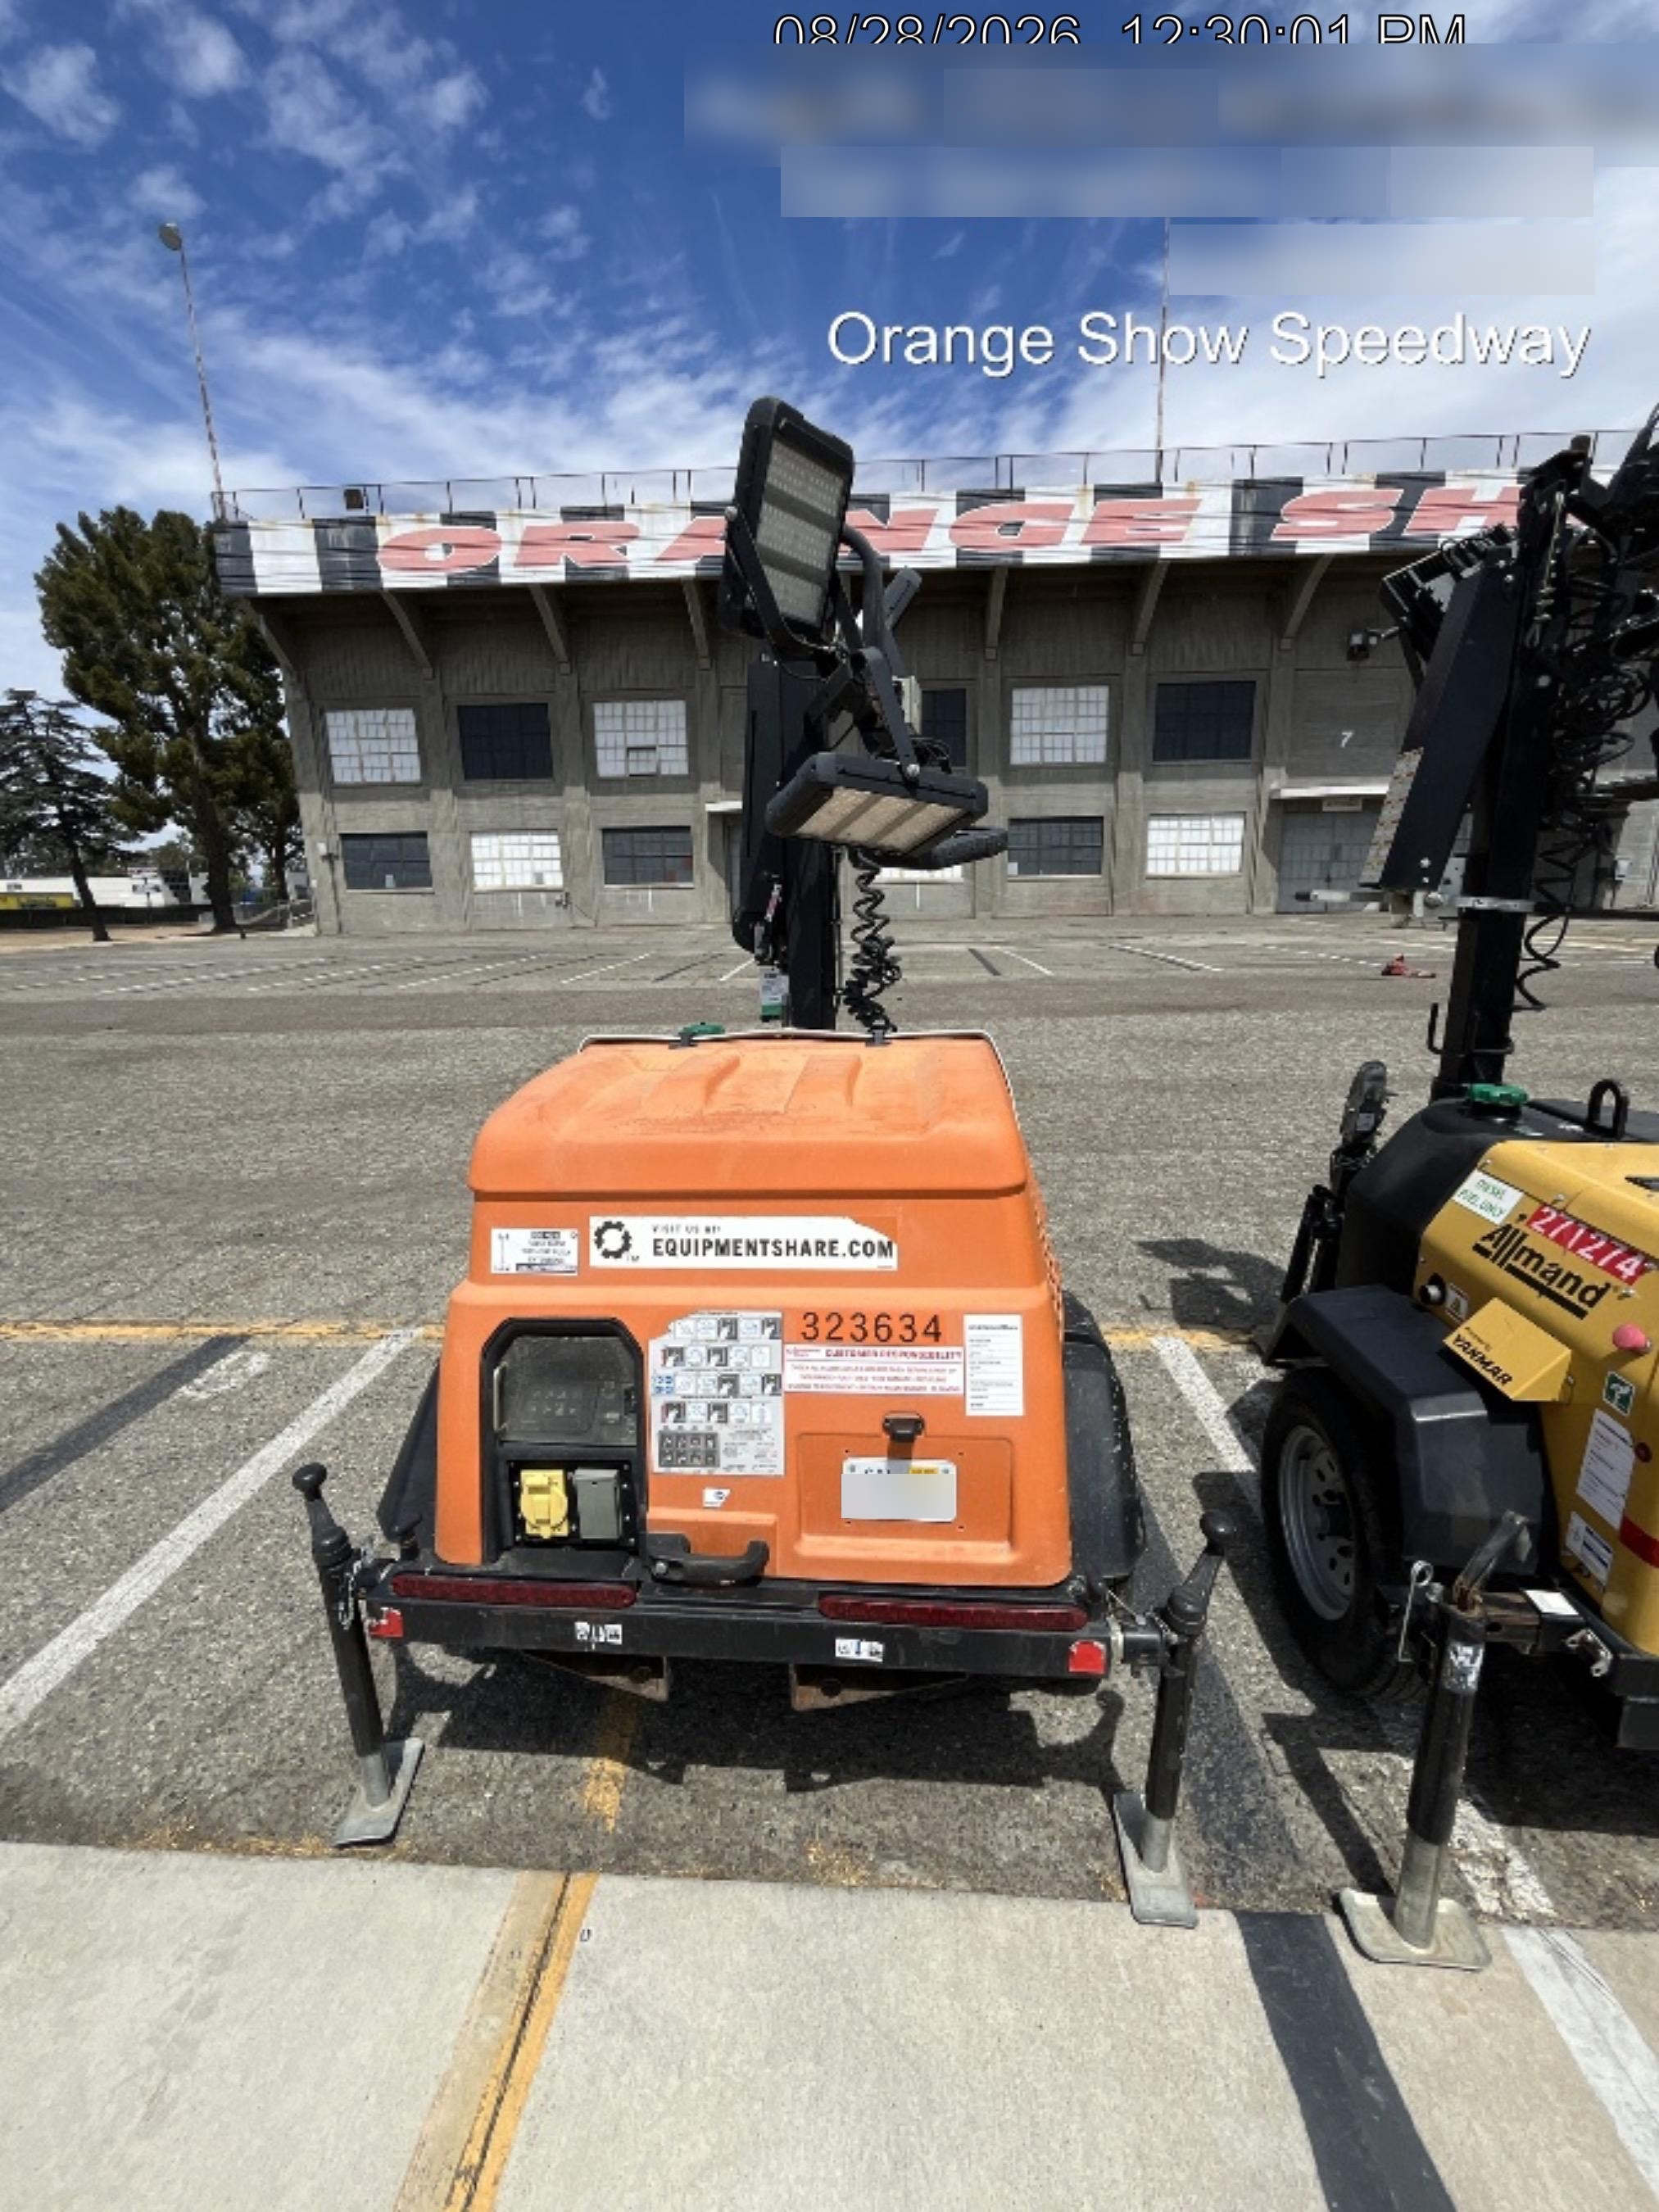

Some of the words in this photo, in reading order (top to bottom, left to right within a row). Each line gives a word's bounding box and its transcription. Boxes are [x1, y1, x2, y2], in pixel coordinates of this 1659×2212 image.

[1341, 731, 1354, 748] 7
[653, 1238, 893, 1258] EQUIPMENTSHARE.COM
[1480, 1224, 1611, 1309] Allmand
[800, 1312, 942, 1343] 323634
[1452, 1334, 1513, 1386] YANMAR
